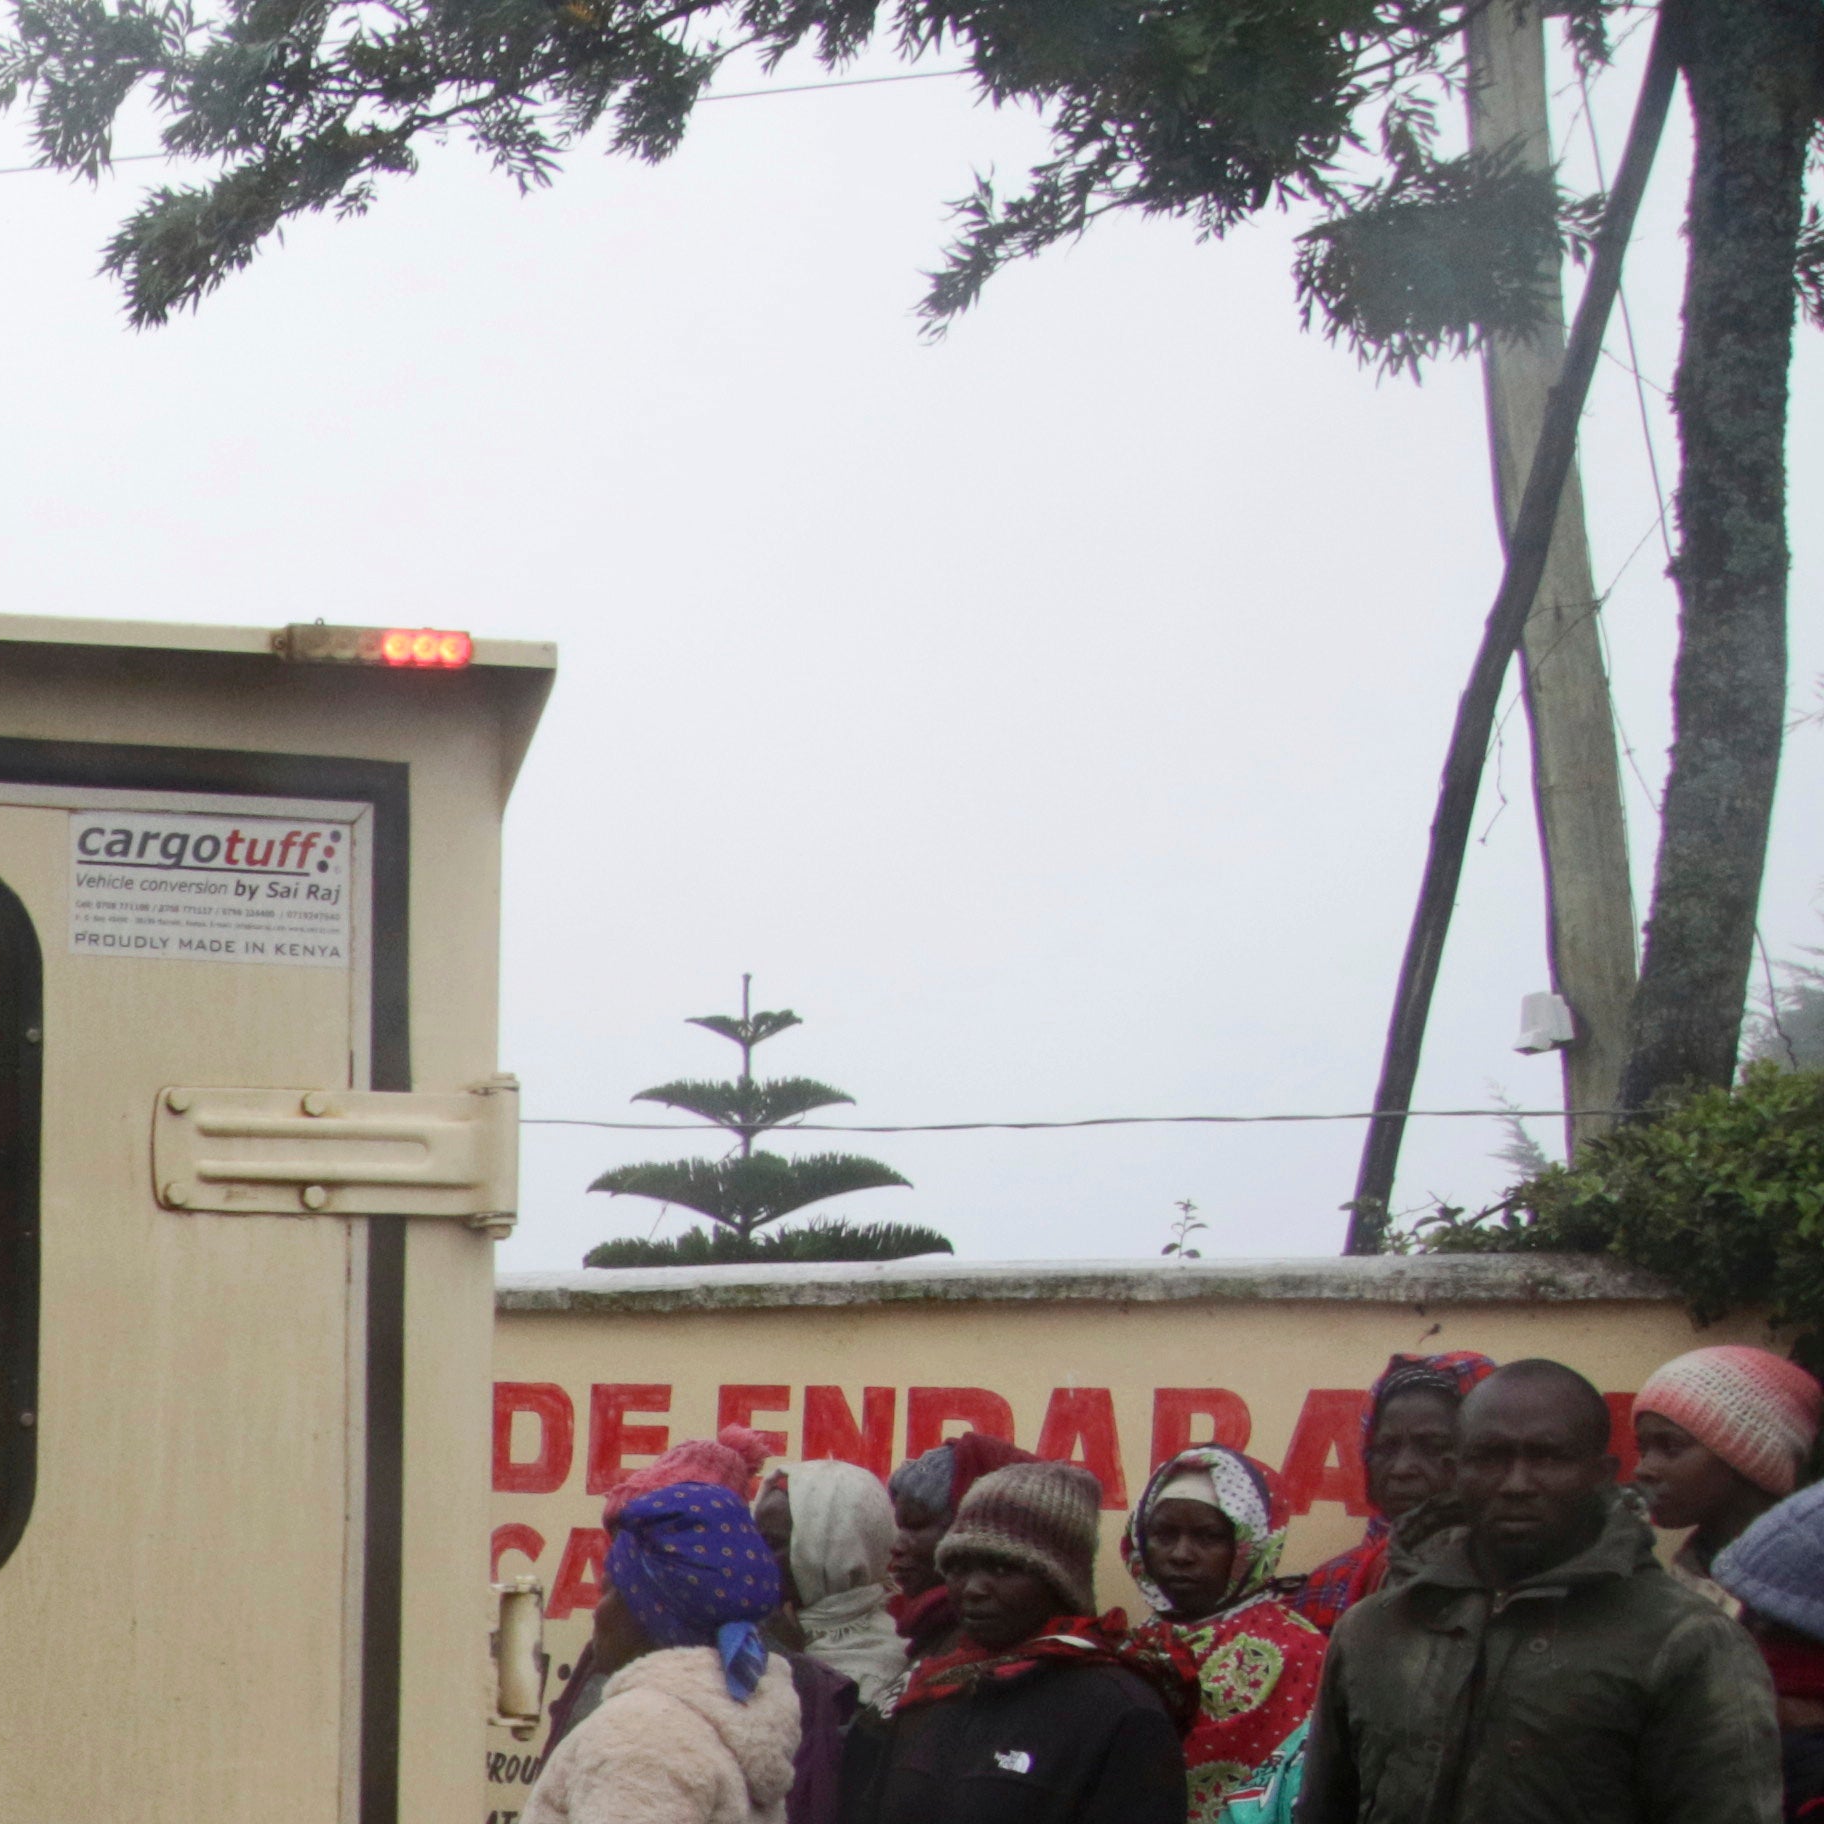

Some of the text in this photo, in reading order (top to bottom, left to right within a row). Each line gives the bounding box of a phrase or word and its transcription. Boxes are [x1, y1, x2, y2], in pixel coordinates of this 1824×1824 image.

[77, 826, 322, 868] cargotuff
[75, 872, 342, 905] Vehicle conversion by Sai Raj
[75, 932, 342, 960] PROUDLY MADE IN KENYA
